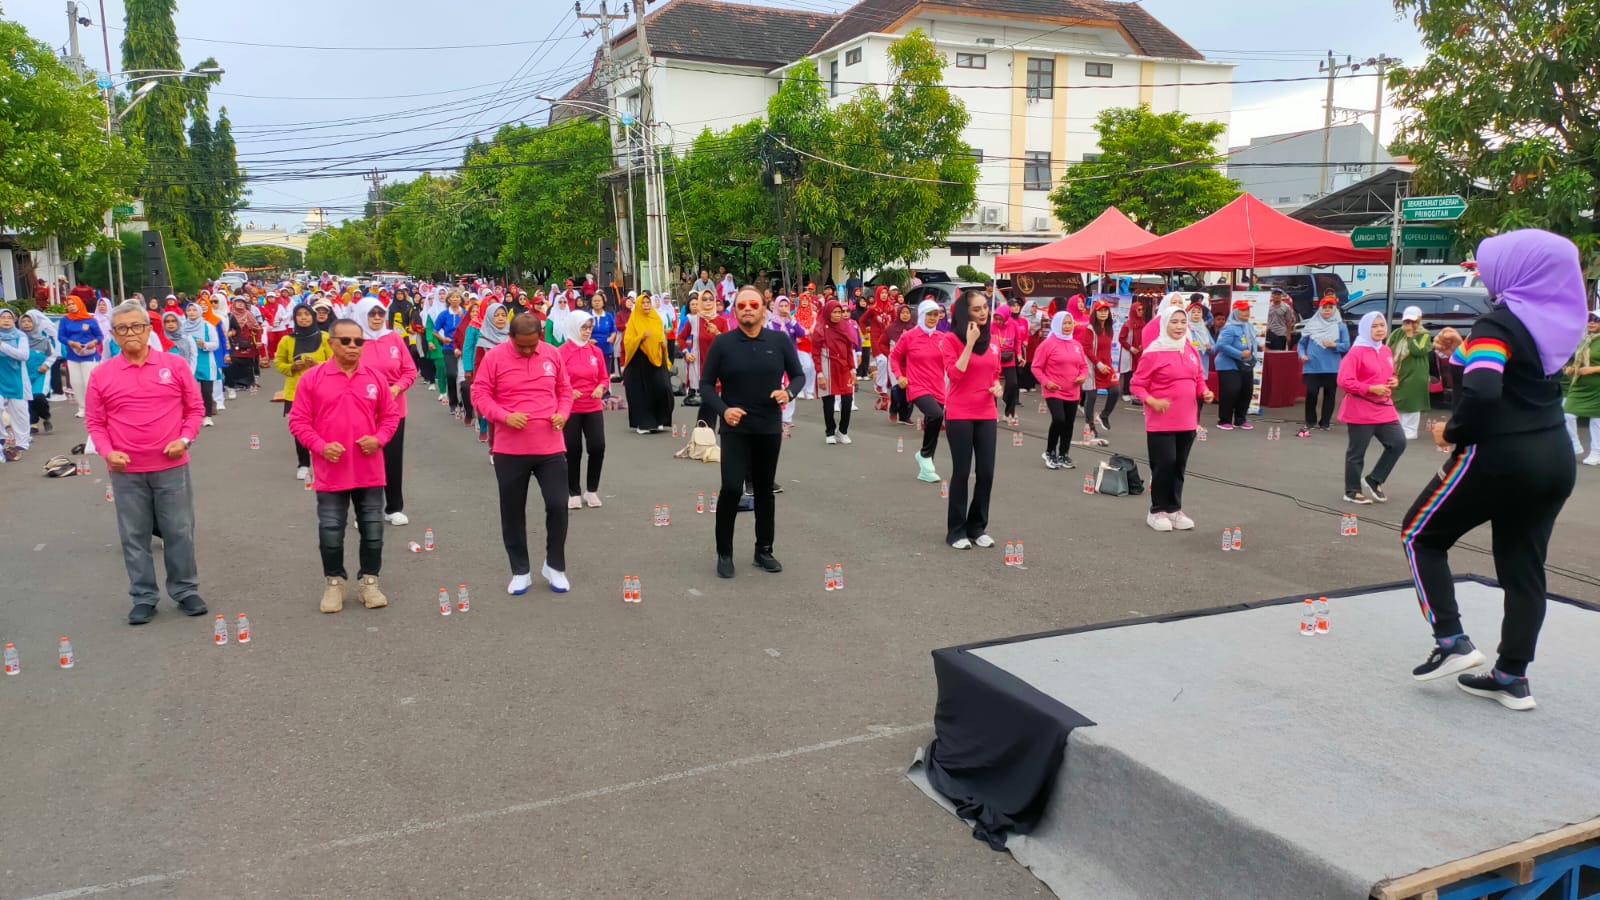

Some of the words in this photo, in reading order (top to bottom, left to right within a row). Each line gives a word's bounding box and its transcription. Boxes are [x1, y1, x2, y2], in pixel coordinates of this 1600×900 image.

[1407, 199, 1439, 207] SEKRETARIAT
[1439, 198, 1459, 206] DAERAH
[1414, 209, 1449, 218] PRINGGITAN
[1405, 233, 1428, 241] KOPERASI
